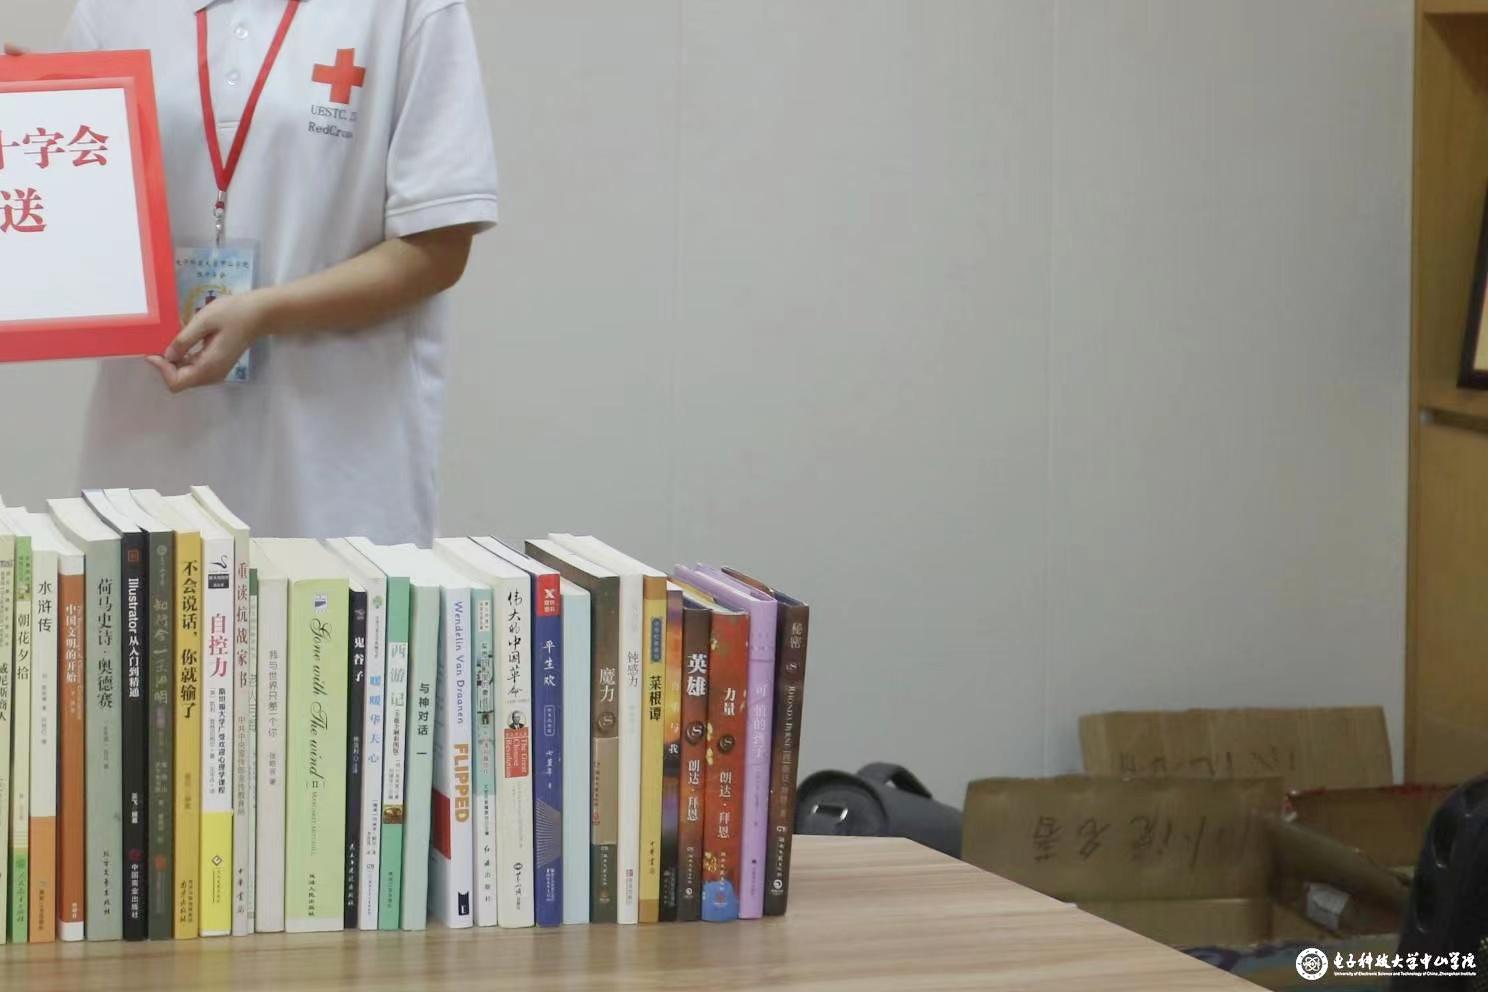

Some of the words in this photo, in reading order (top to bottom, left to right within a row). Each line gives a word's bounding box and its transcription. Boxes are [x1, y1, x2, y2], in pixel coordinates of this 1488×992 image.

[38, 580, 52, 633] 水浒传
[236, 562, 248, 689] 重读抗战家书
[454, 601, 464, 652] Wendelin
[17, 613, 30, 680] 朝花夕拾
[65, 603, 77, 683] 中国文明的开始
[97, 577, 113, 709] 荷马史诗·奥德赛
[208, 612, 228, 678] 自控力
[310, 618, 331, 660] Gone
[354, 637, 366, 682] 鬼谷子
[507, 588, 523, 698] 伟大的中国革命
[790, 622, 803, 649] 秘密
[312, 664, 327, 696] with
[390, 643, 406, 707] 西游记
[456, 655, 464, 676] Van
[543, 639, 556, 687] 平生欢
[599, 666, 617, 703] 魔力
[627, 651, 639, 688] 钝感力
[686, 653, 708, 697] 英雄
[268, 649, 278, 738] 我与世界只差一个你
[417, 683, 430, 736] 与神对话
[456, 679, 465, 725] Draanen
[649, 675, 662, 721] 菜根谭
[723, 687, 736, 716] 力量
[310, 701, 328, 736] The
[309, 739, 325, 780] wind
[453, 743, 470, 823] FLIPPED
[687, 759, 700, 822] 朗达·拜恩
[717, 771, 732, 839] 朗达·拜恩
